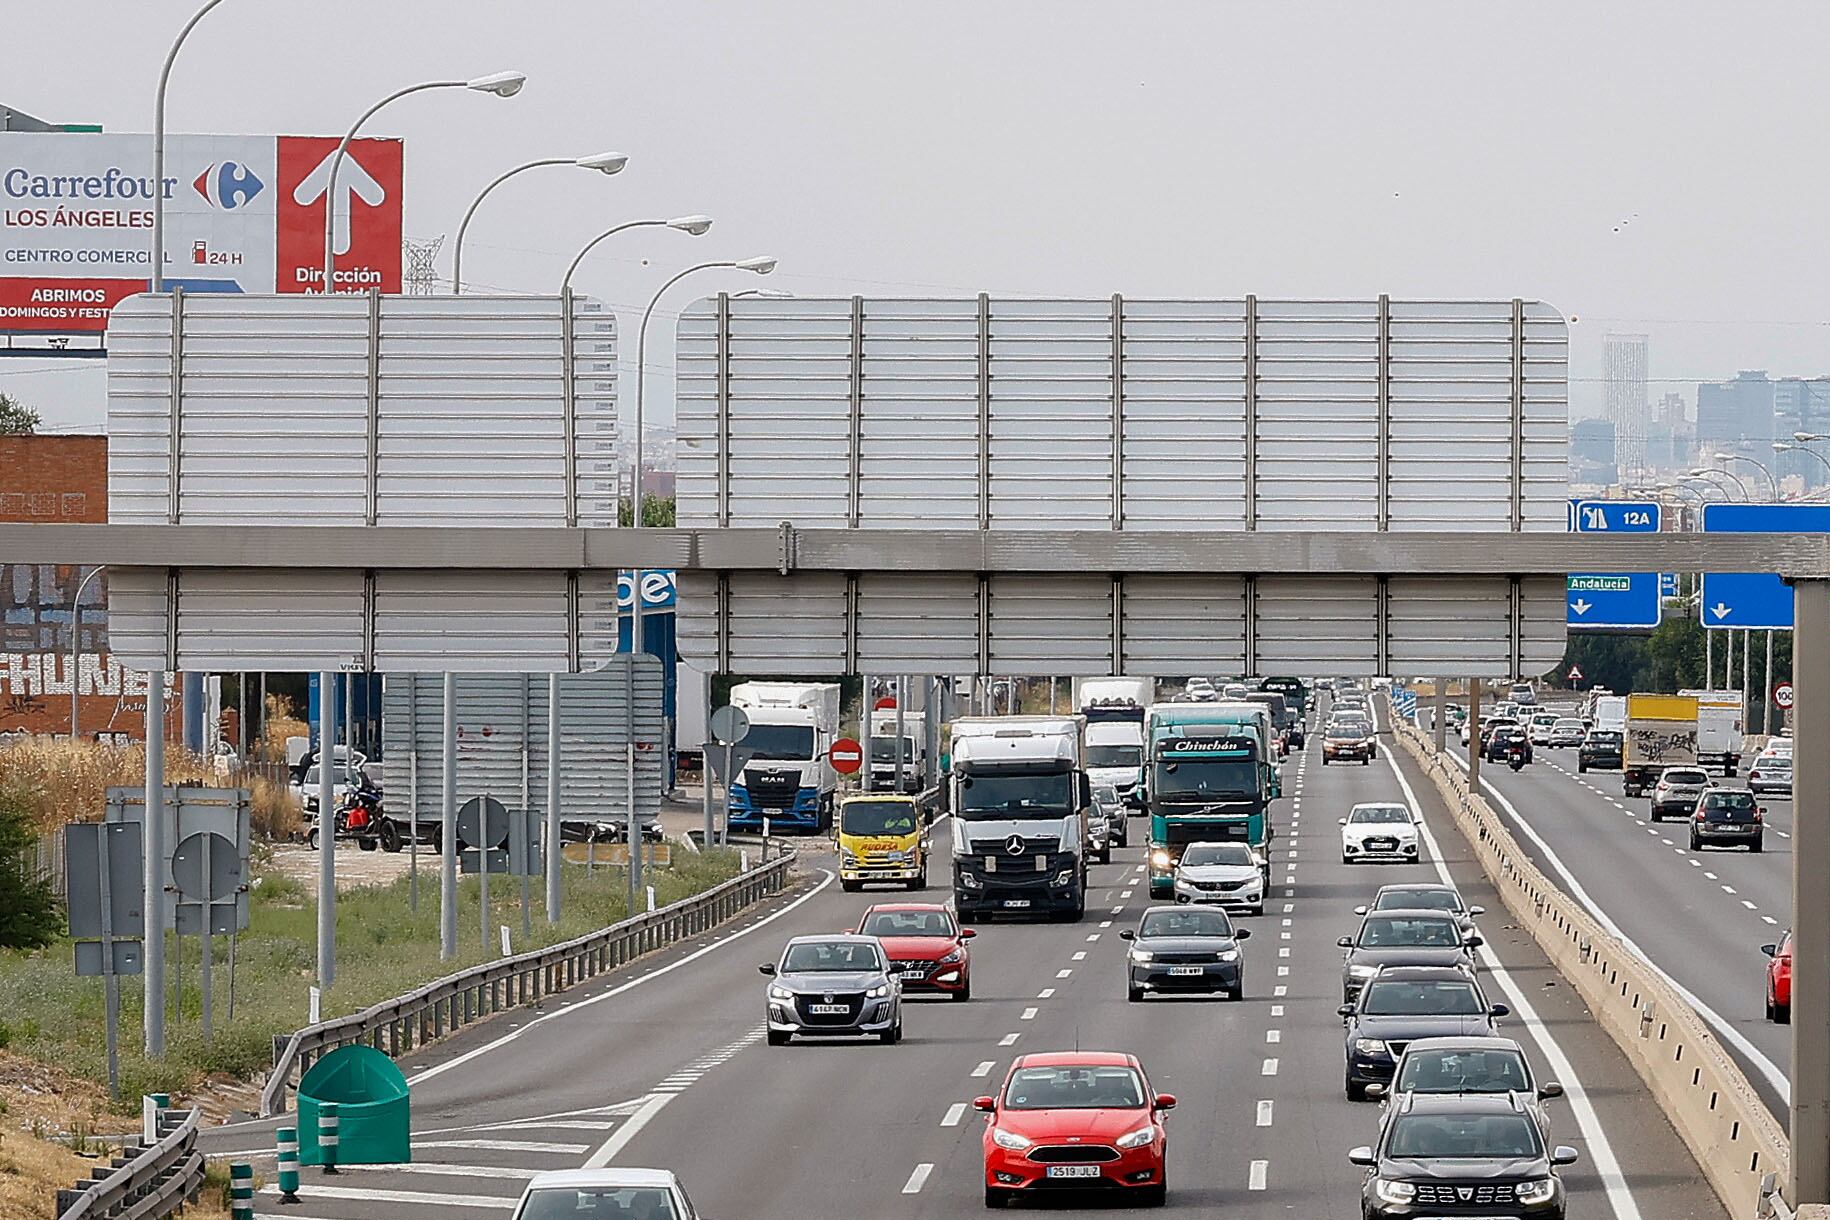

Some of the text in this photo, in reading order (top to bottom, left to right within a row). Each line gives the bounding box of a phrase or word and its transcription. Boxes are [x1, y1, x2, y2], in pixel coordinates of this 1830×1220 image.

[4, 168, 178, 199] Carrefour
[5, 205, 154, 228] LOS ÁNGELES
[5, 250, 173, 265] CENTRO COMERCIL
[209, 253, 243, 265] 24 H
[296, 267, 381, 283] Dircción
[31, 288, 105, 303] ABRIMOS
[0, 307, 67, 318] DOMINGOS
[69, 308, 78, 317] Y
[1623, 512, 1650, 525] 12A
[1570, 578, 1628, 589] Andalucía
[1174, 740, 1238, 752] Chinchón
[760, 776, 785, 784] MAN
[1053, 1165, 1098, 1177] 2519 JLZ
